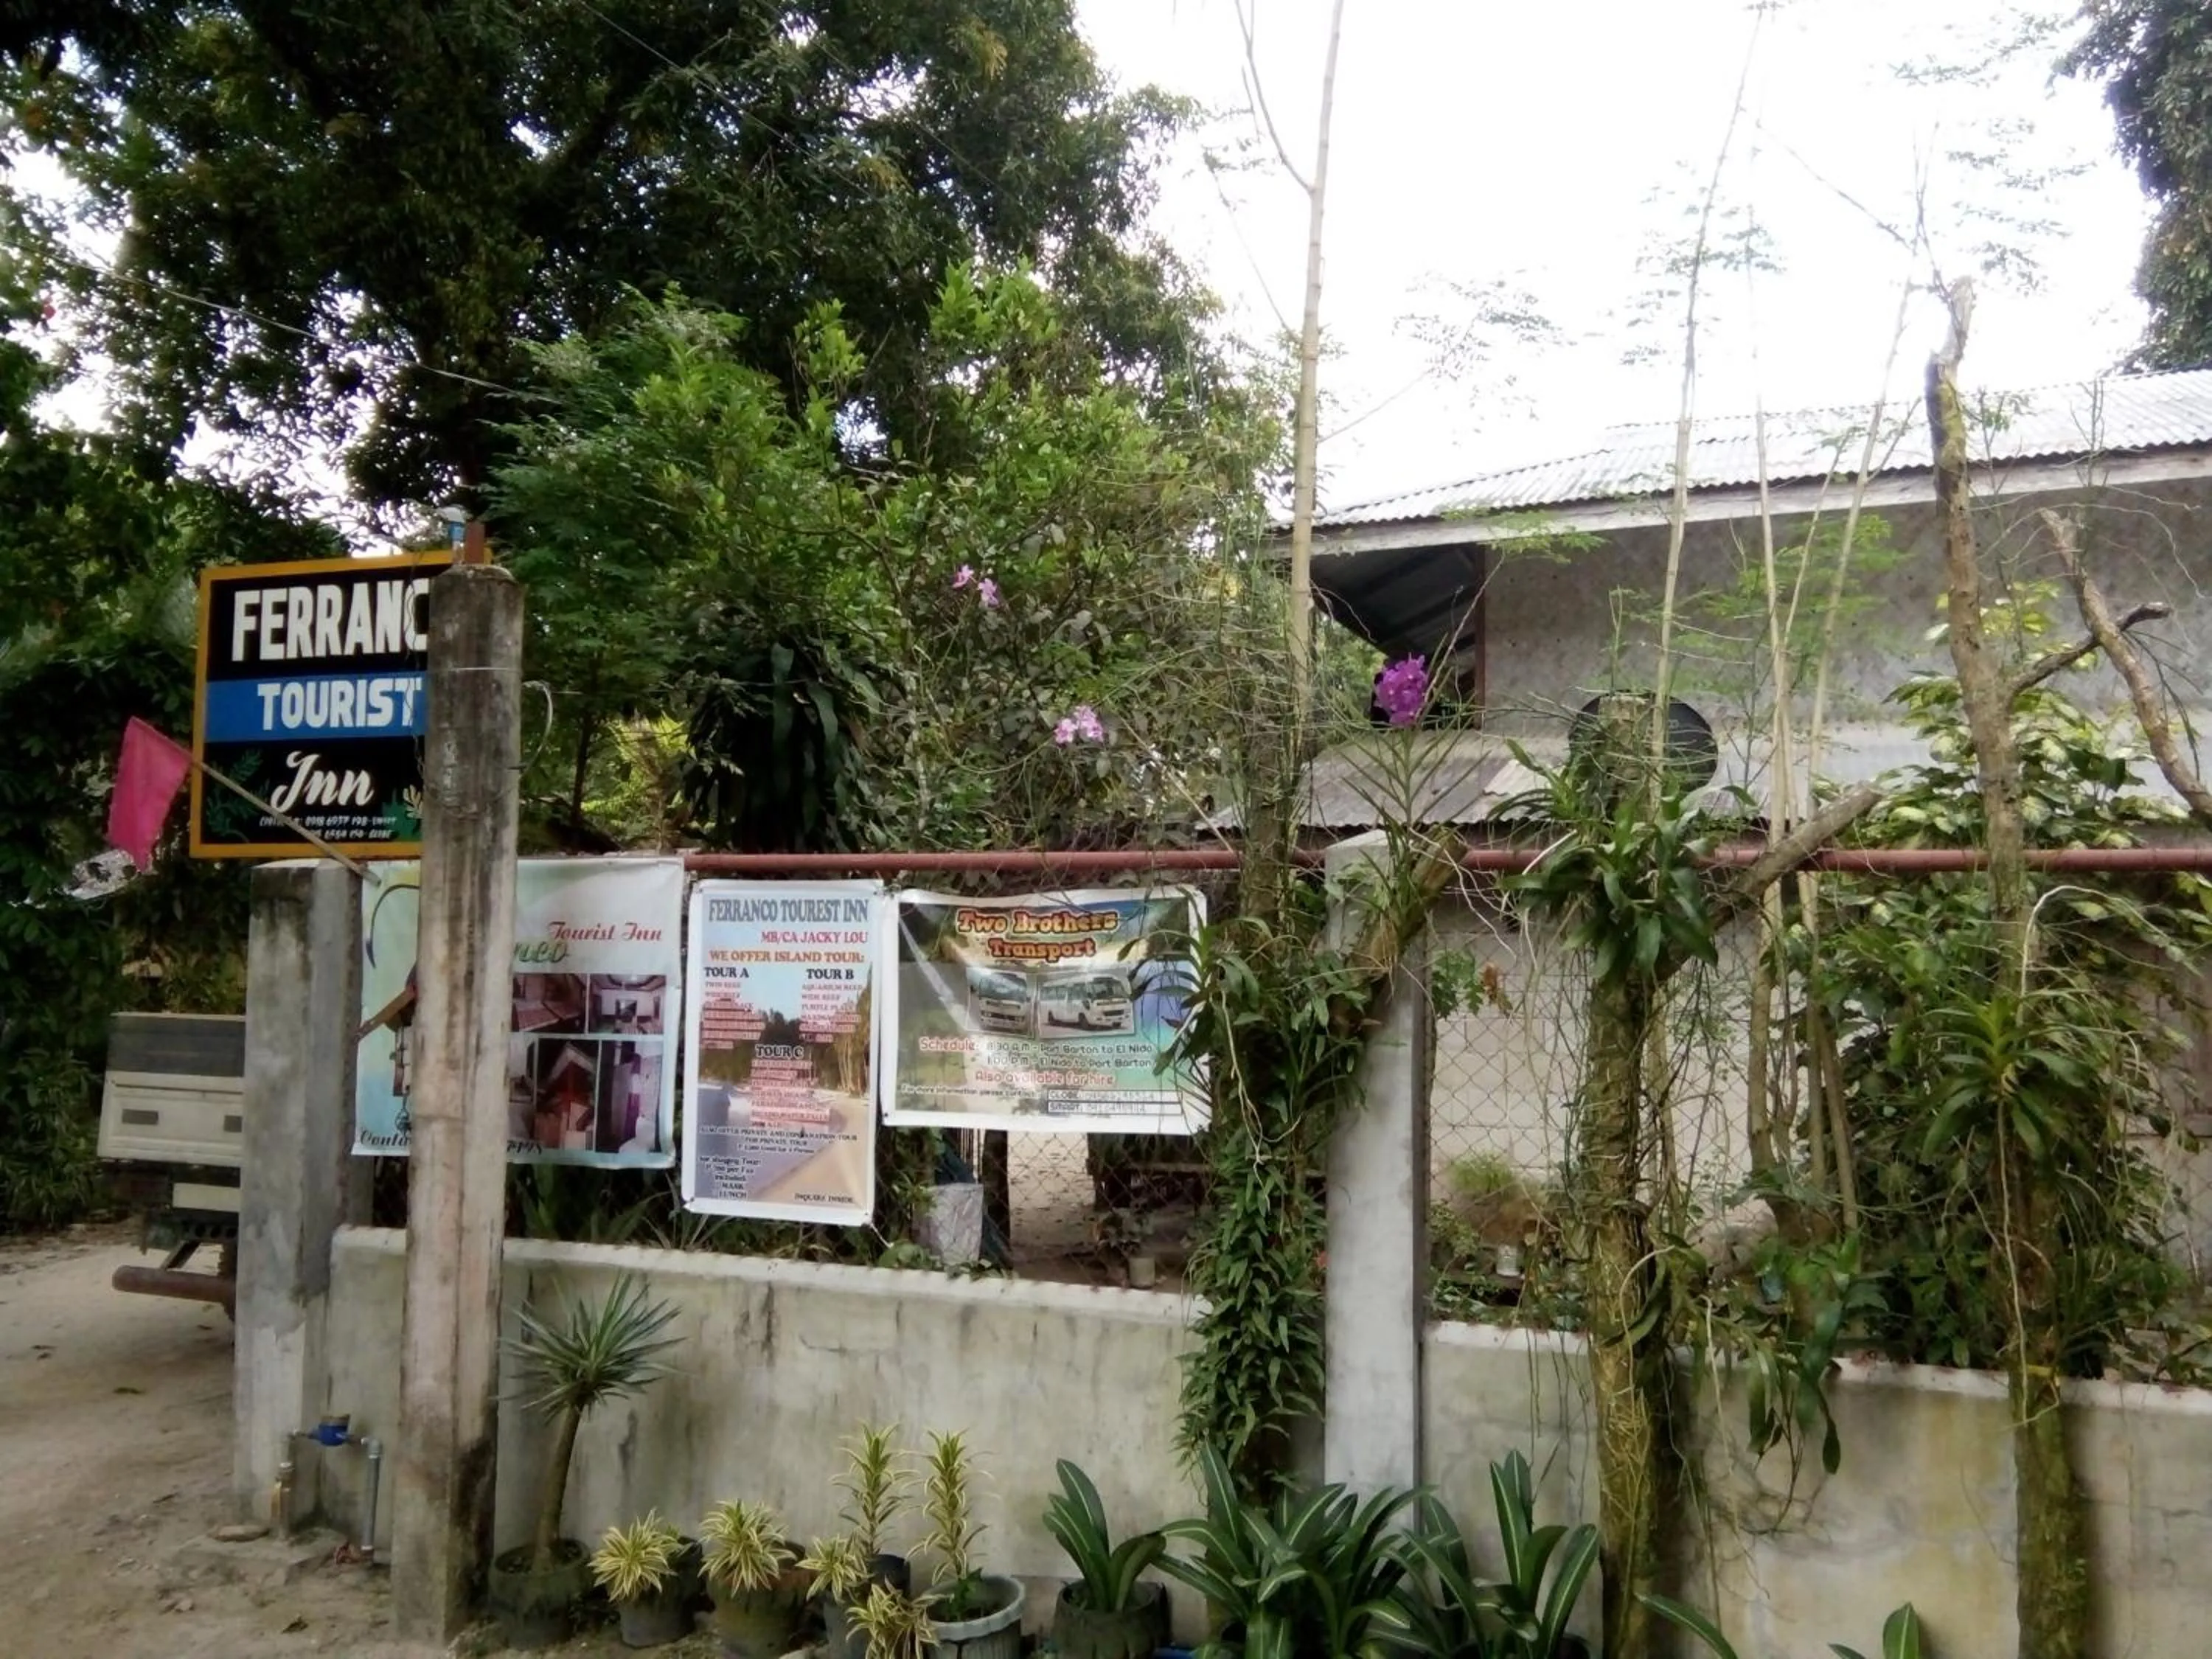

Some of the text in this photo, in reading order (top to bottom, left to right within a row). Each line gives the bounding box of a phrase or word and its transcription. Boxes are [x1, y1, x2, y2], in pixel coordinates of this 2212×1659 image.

[232, 578, 429, 661] FERRANC
[257, 677, 422, 730] TOURIST
[270, 751, 374, 813] Inn
[708, 899, 869, 923] FERRANCO TOUREST INN
[959, 909, 1118, 934] Two Brothers
[548, 921, 663, 942] Tourist Inn
[761, 931, 869, 944] MB/CA JACKY LOU
[709, 950, 728, 961] WE
[731, 950, 771, 962] OFFER
[774, 951, 822, 963] ISLAND
[989, 937, 1096, 961] Transport
[705, 967, 750, 978] TOUR A
[807, 968, 855, 980] TOUR B
[757, 1046, 804, 1058] TOUR C
[1062, 1044, 1099, 1054] Barton
[1102, 1044, 1113, 1054] to
[1116, 1044, 1126, 1053] El
[1129, 1044, 1152, 1053] Nido
[1114, 1058, 1152, 1067] Barton
[975, 1071, 1002, 1082] Also
[1089, 1073, 1114, 1084] hire
[360, 1130, 411, 1147] Conta
